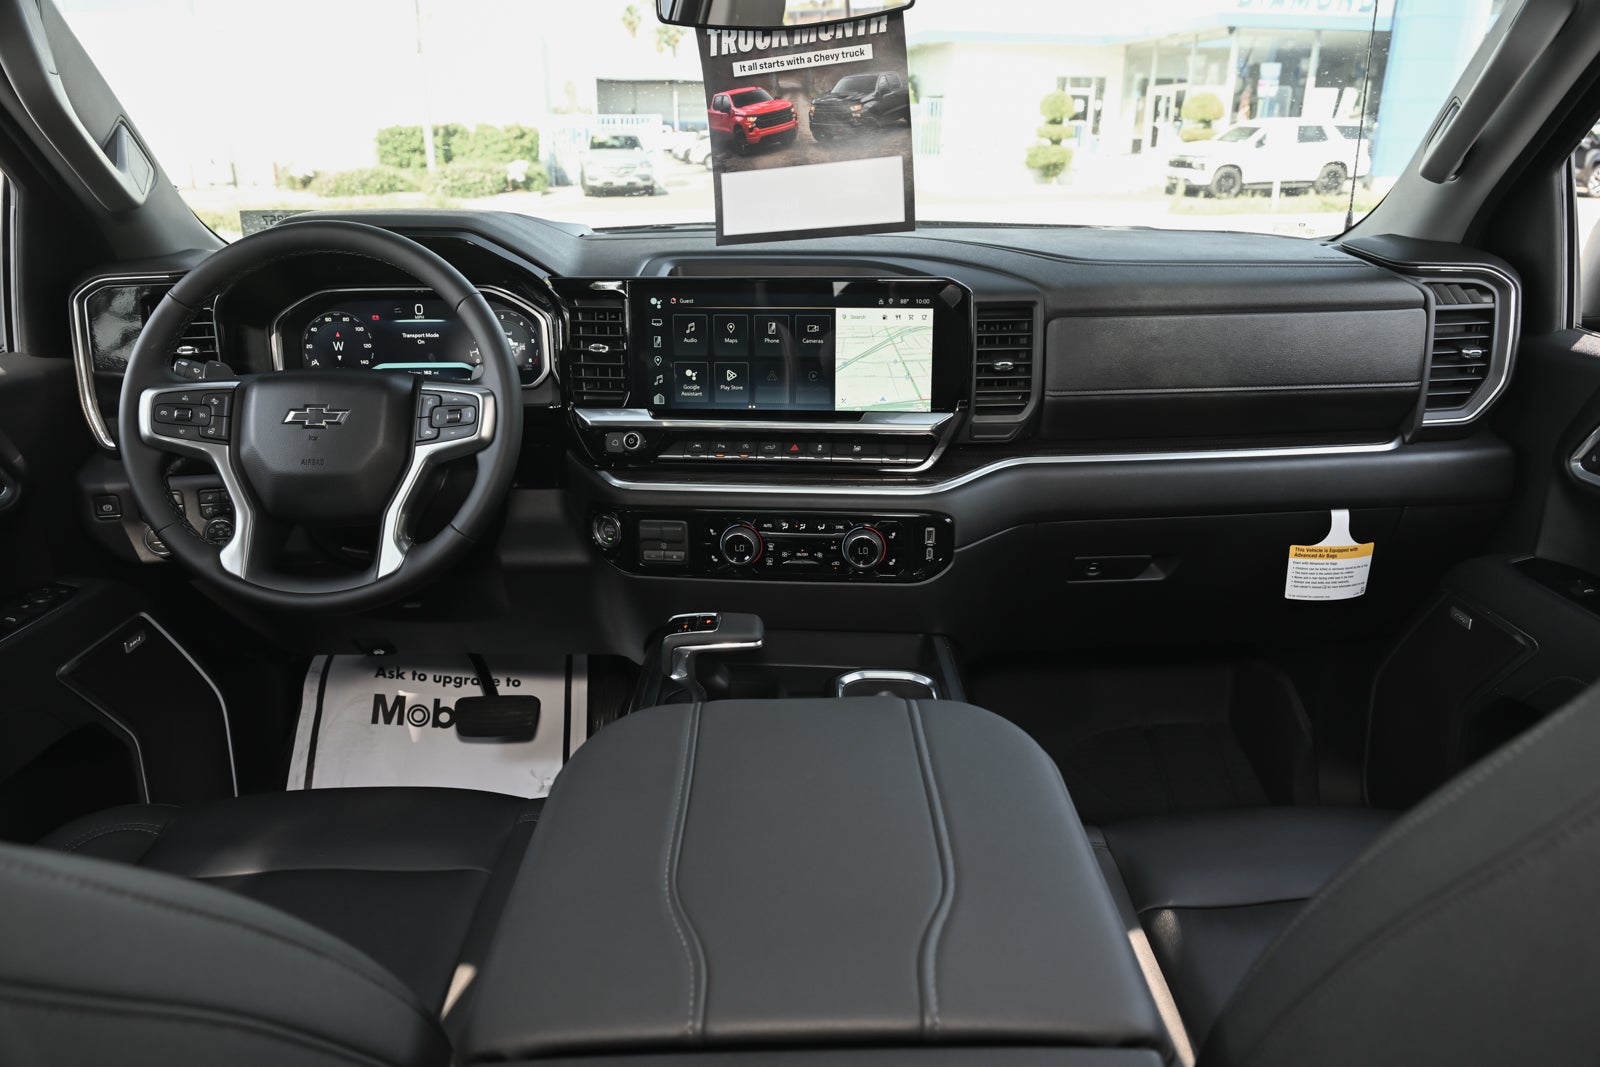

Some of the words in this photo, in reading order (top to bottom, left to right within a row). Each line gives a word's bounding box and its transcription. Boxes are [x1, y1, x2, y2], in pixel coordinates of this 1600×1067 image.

[739, 64, 746, 73] It
[748, 62, 758, 72] all
[759, 59, 785, 70] starts
[786, 55, 805, 66] with
[814, 52, 840, 63] Chevy
[842, 48, 865, 59] truck
[414, 304, 424, 315] 0
[332, 341, 344, 352] W
[374, 667, 406, 680] Ask
[411, 669, 428, 682] to
[432, 672, 501, 688] upgrae
[506, 676, 522, 688] to
[371, 693, 457, 729] Mob
